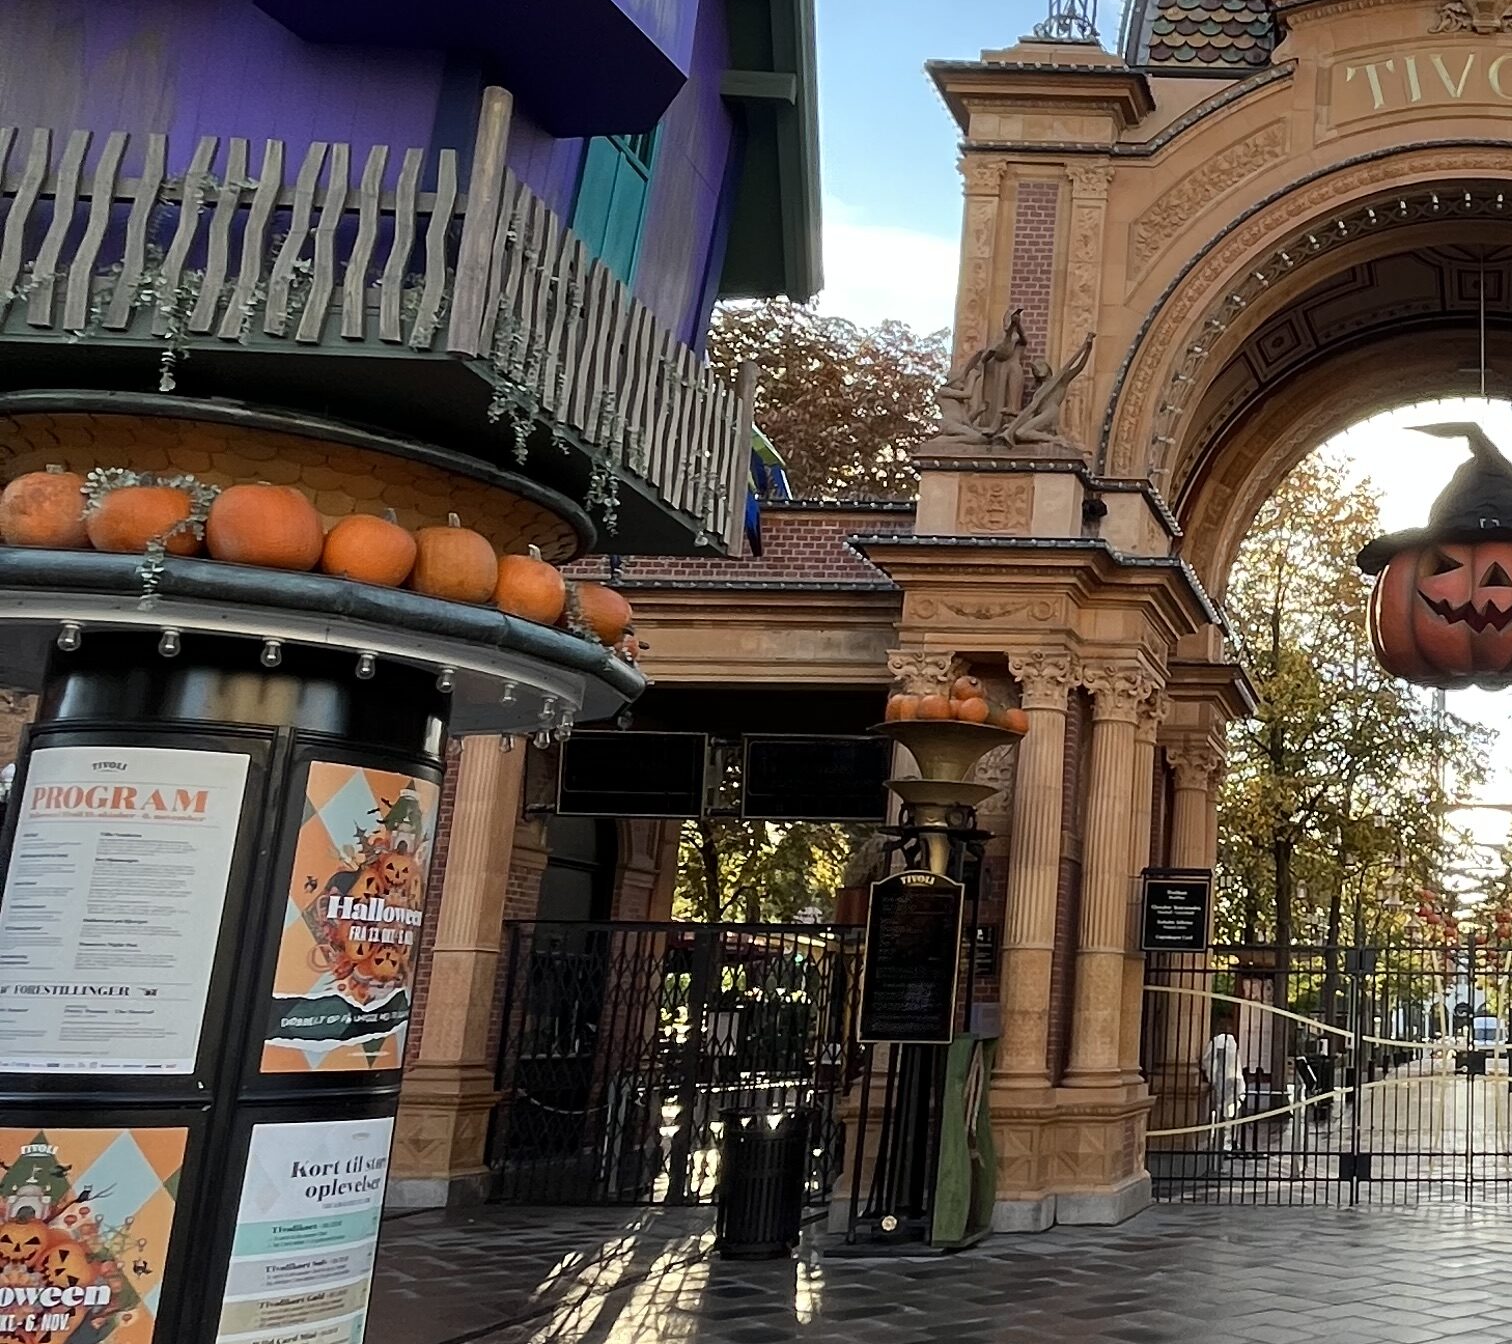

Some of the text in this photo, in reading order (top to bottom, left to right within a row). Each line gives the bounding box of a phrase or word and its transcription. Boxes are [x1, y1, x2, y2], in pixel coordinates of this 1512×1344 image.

[92, 761, 128, 771] TIVOLI
[31, 784, 210, 814] PROGRAM
[900, 874, 936, 885] TIVOLI
[21, 1143, 59, 1155] TIVOLI
[290, 1159, 341, 1178] Kort
[346, 1155, 363, 1174] til
